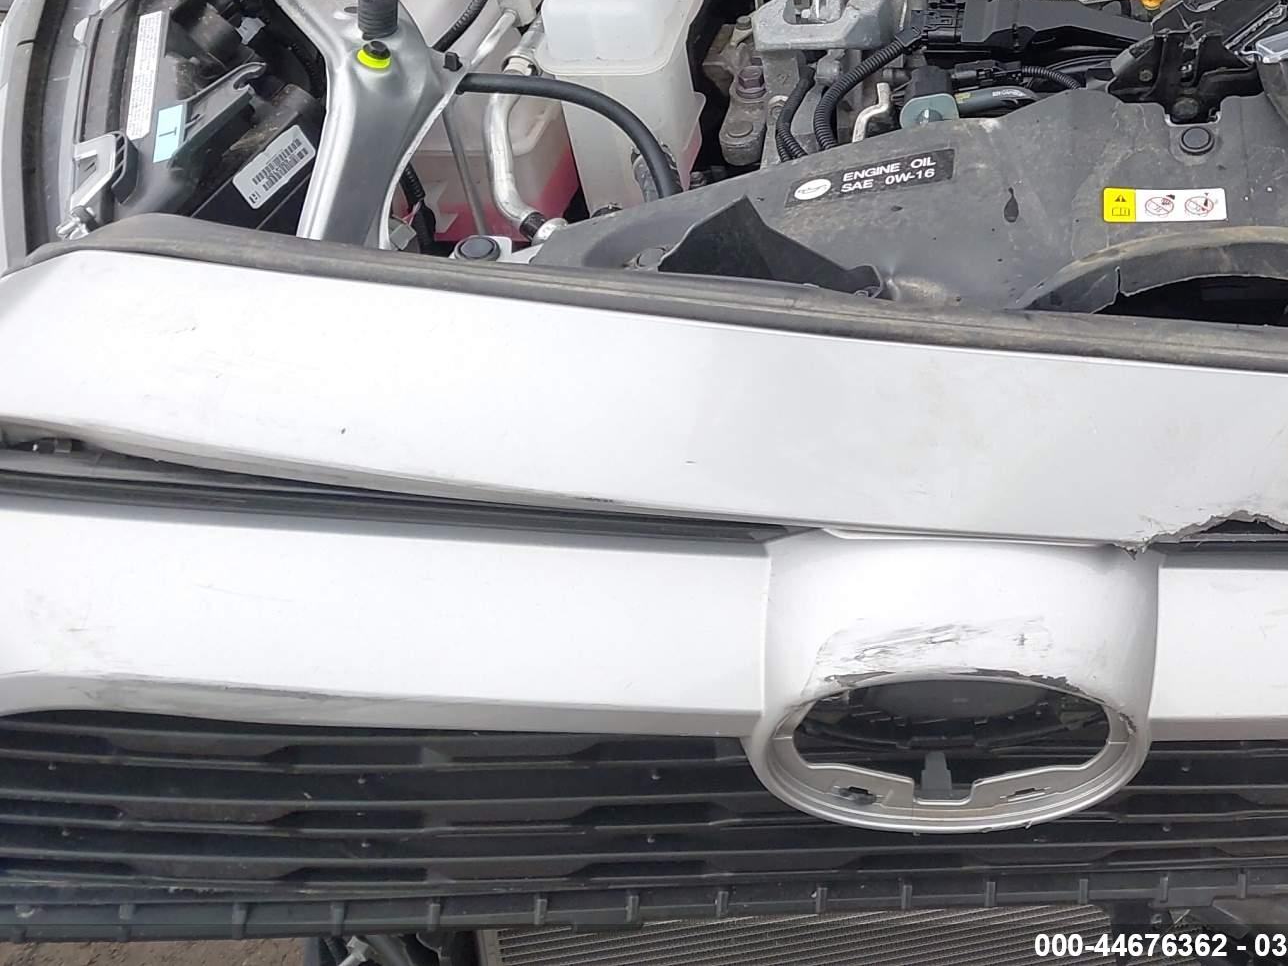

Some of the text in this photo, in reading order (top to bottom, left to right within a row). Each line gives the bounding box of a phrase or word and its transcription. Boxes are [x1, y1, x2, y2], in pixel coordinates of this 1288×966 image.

[840, 168, 936, 193] SAE 0W-16
[842, 156, 937, 182] ENGINE OIL
